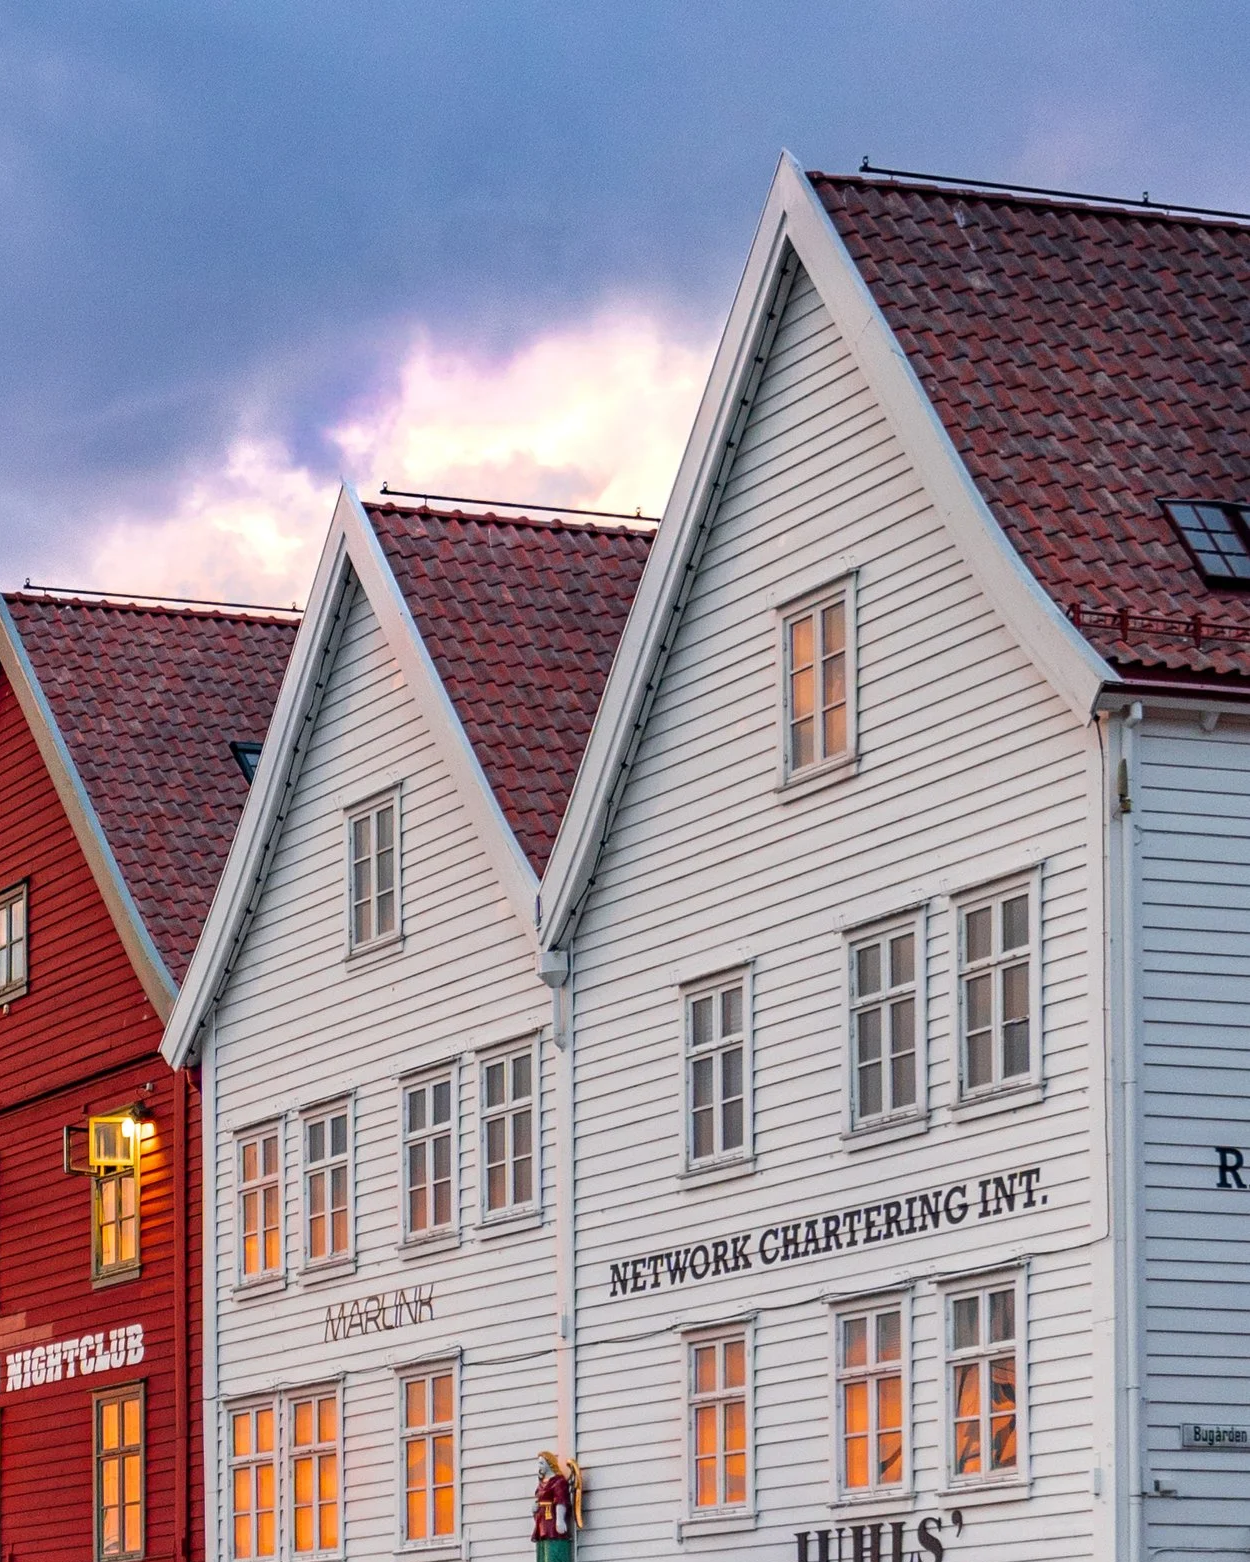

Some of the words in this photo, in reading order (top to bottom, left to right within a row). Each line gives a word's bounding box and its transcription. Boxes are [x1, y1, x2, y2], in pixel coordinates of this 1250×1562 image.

[1214, 1146, 1250, 1189] R
[609, 1234, 751, 1297] NETWORK
[758, 1184, 970, 1266] CHARTERING
[978, 1167, 1049, 1219] INT.
[323, 1282, 435, 1343] MARLINK
[5, 1323, 145, 1392] NIGHTCLUB
[1193, 1426, 1248, 1446] Bugården
